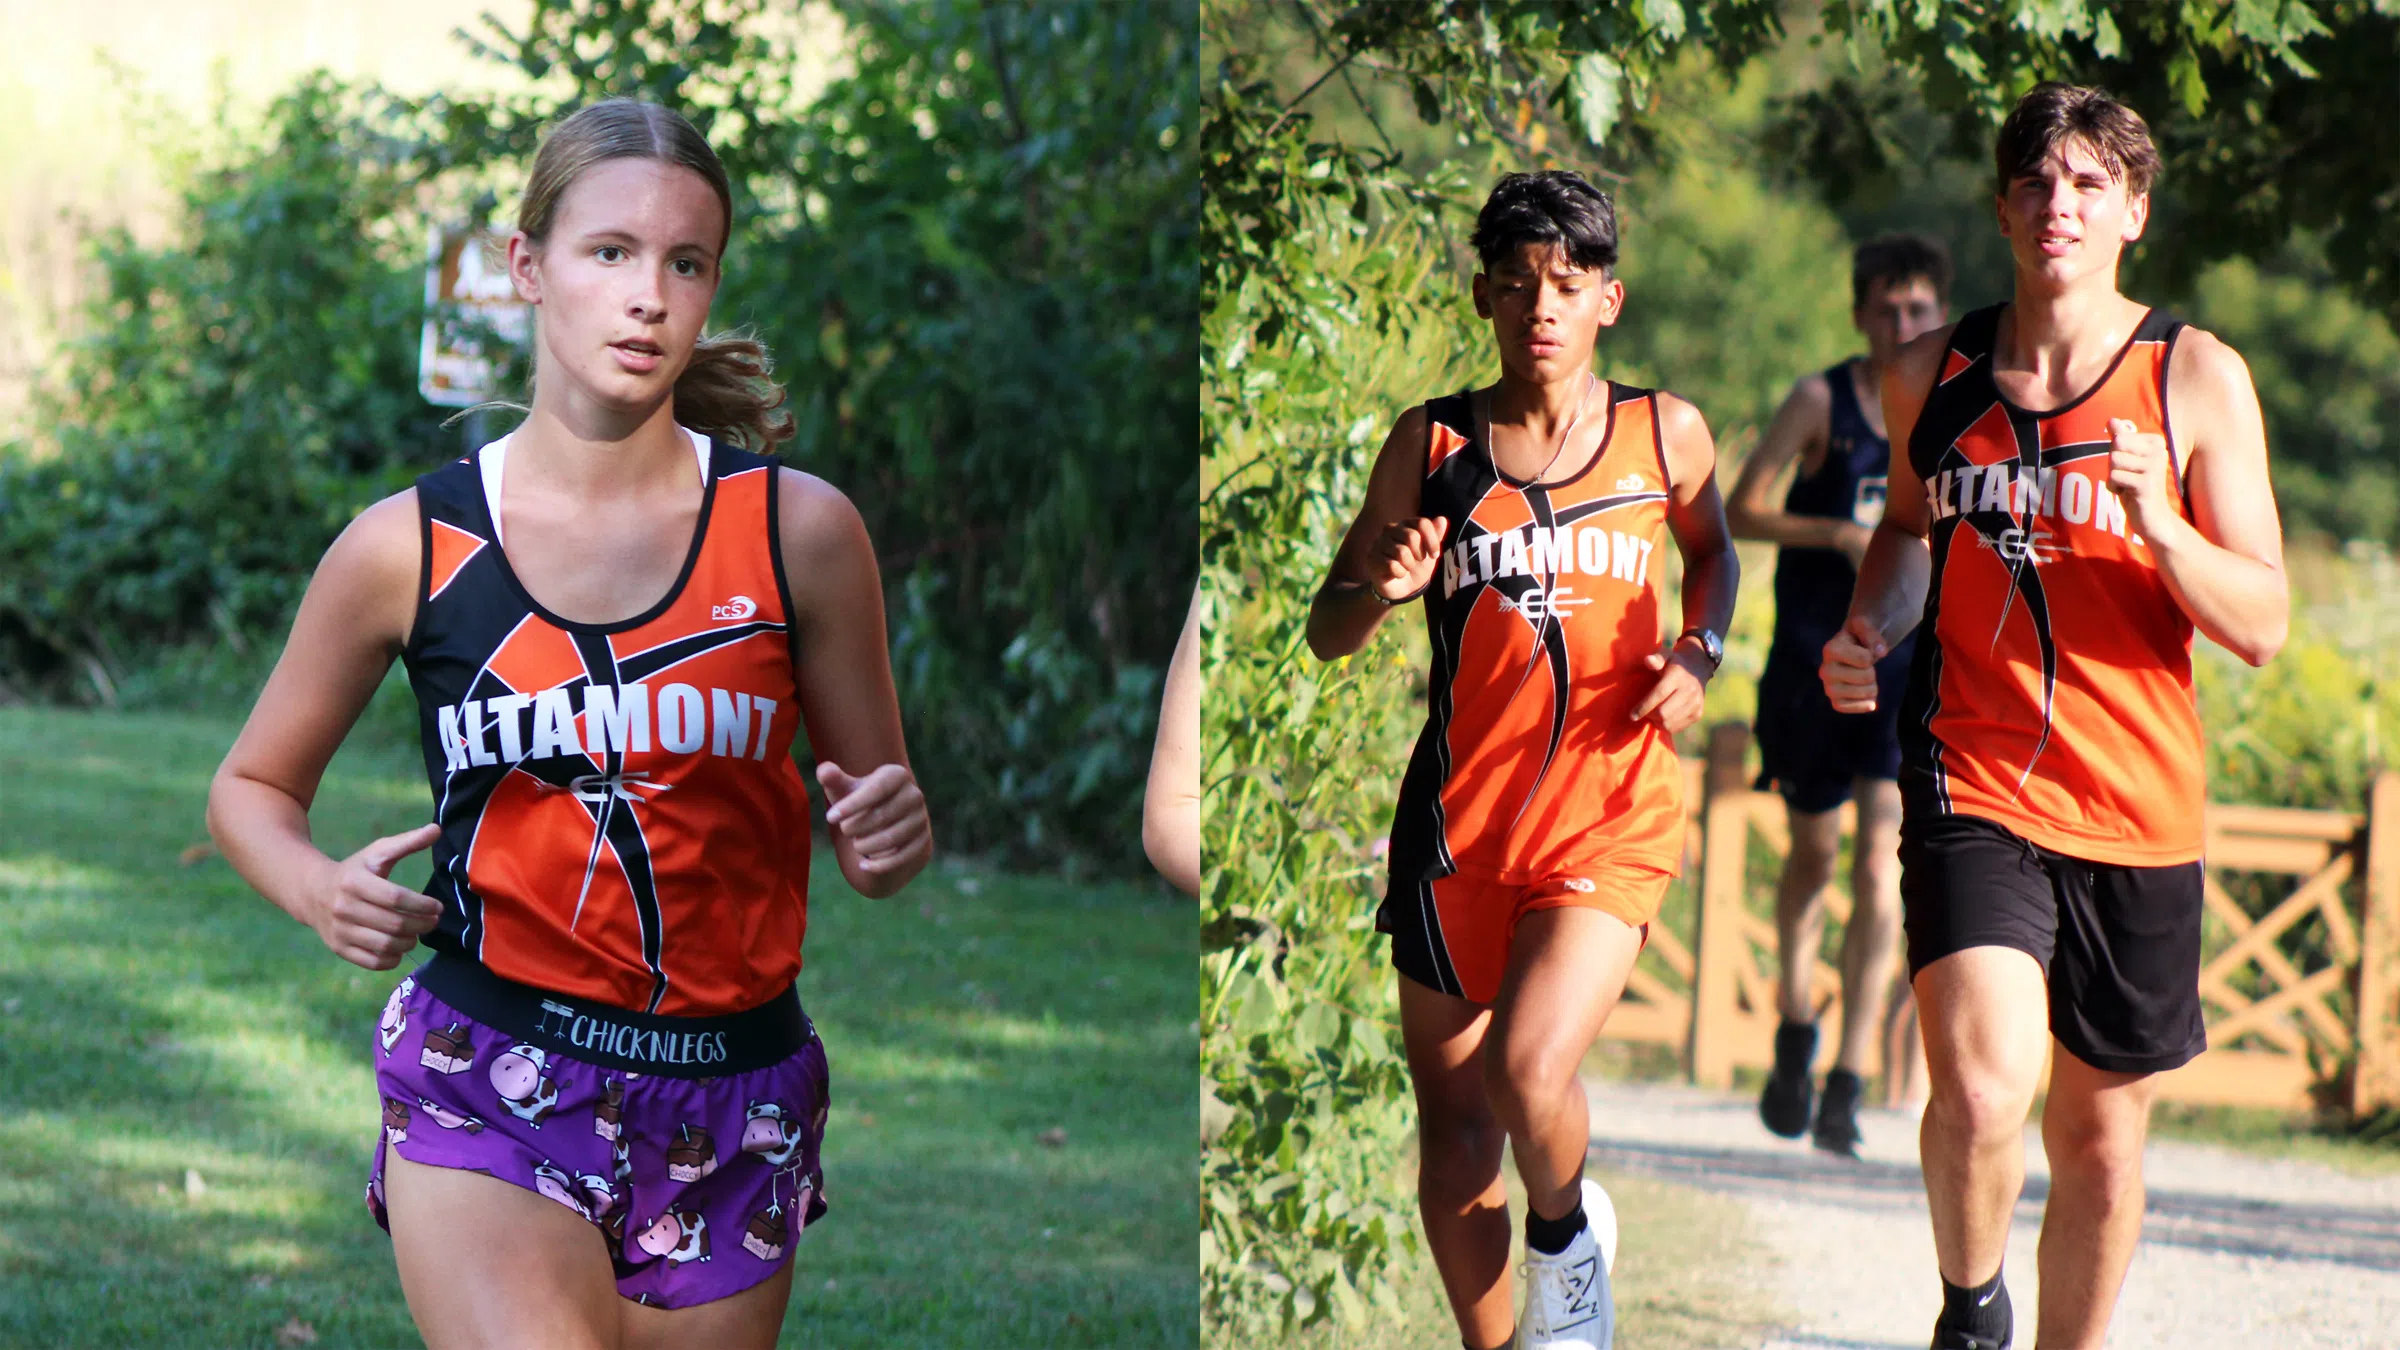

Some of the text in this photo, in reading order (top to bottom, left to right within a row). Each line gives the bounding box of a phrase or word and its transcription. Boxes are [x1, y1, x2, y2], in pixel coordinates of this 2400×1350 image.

[1925, 465, 2144, 546] LTAMON
[1443, 526, 1654, 600] ALTAMONT
[438, 683, 777, 771] ALTAMONT
[570, 1015, 727, 1064] CHICKNLEGS
